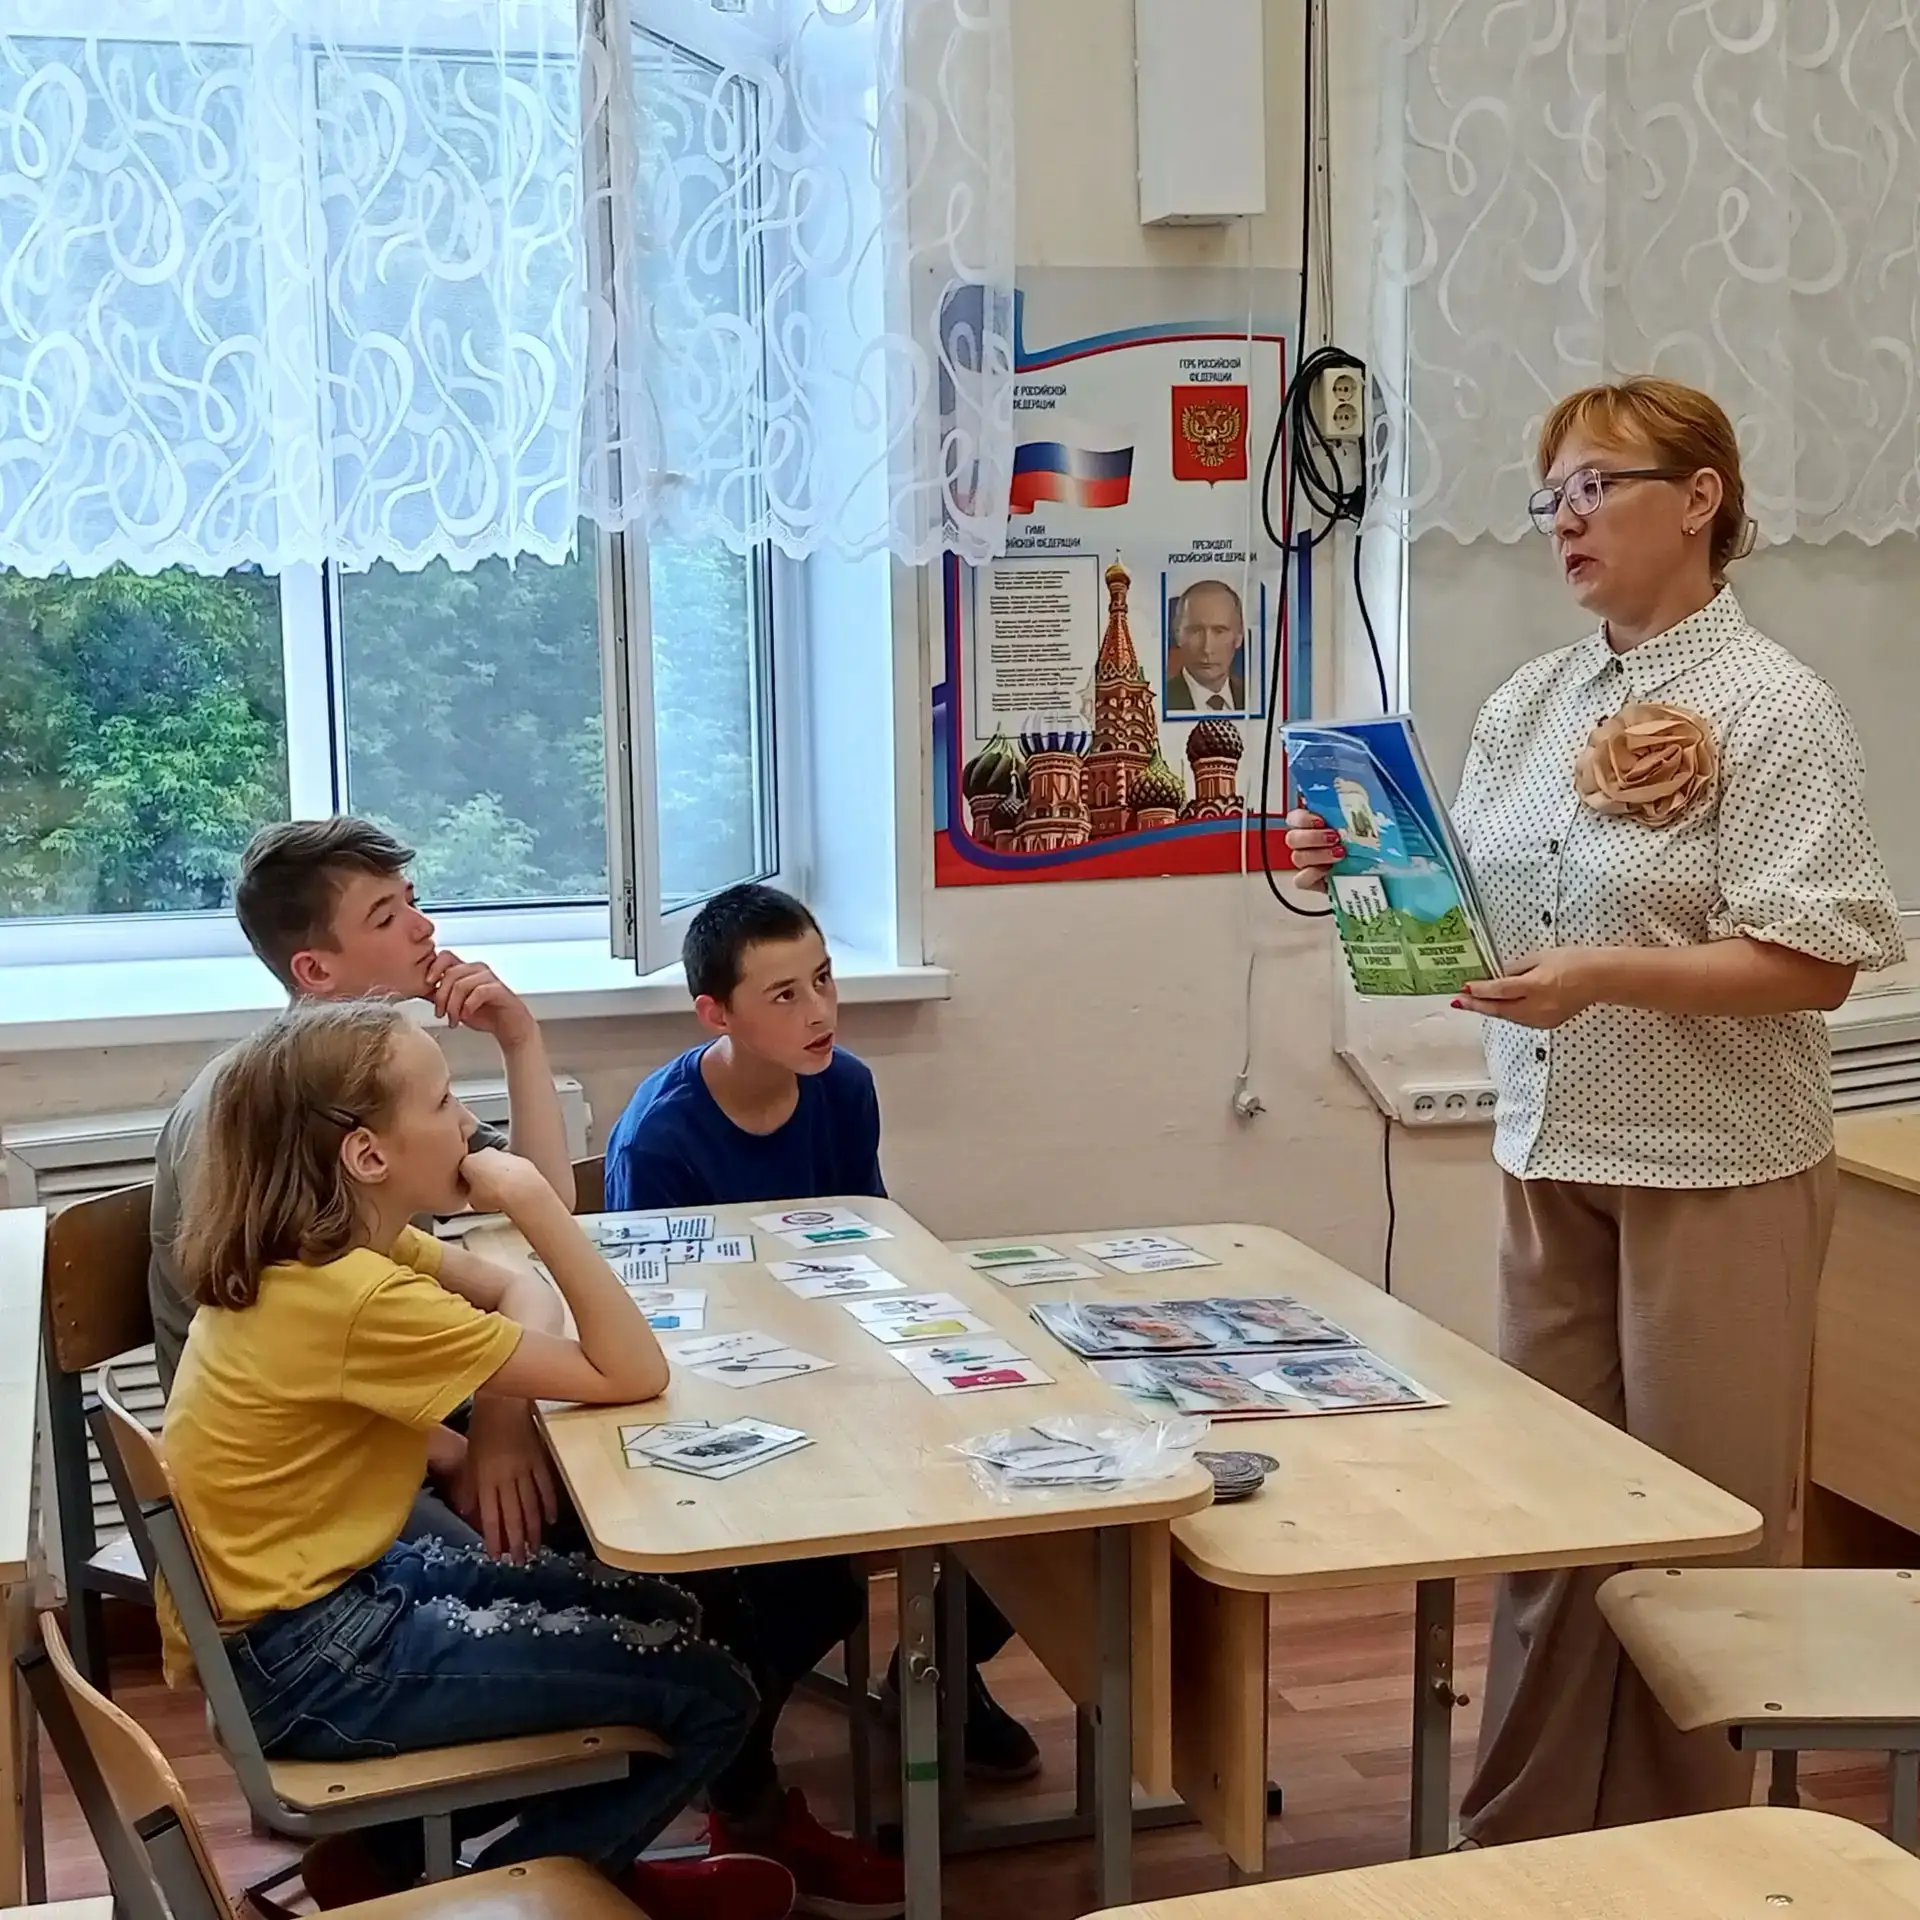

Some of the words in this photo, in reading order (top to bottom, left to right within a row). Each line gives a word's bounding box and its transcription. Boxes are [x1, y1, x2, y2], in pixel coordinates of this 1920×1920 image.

[1198, 356, 1242, 369] РОССИЙСКОЙ
[1189, 371, 1233, 382] ФЕДЕРАЦИИ
[1021, 384, 1067, 396] РОССИЙСКОЙ
[1025, 525, 1046, 535] ГИМН
[1037, 536, 1081, 549] ФЕДЕРАЦИИ
[1192, 539, 1233, 550] ПРЕЗИДЕНТ
[1168, 551, 1213, 564] РОССИЙСКОЙ
